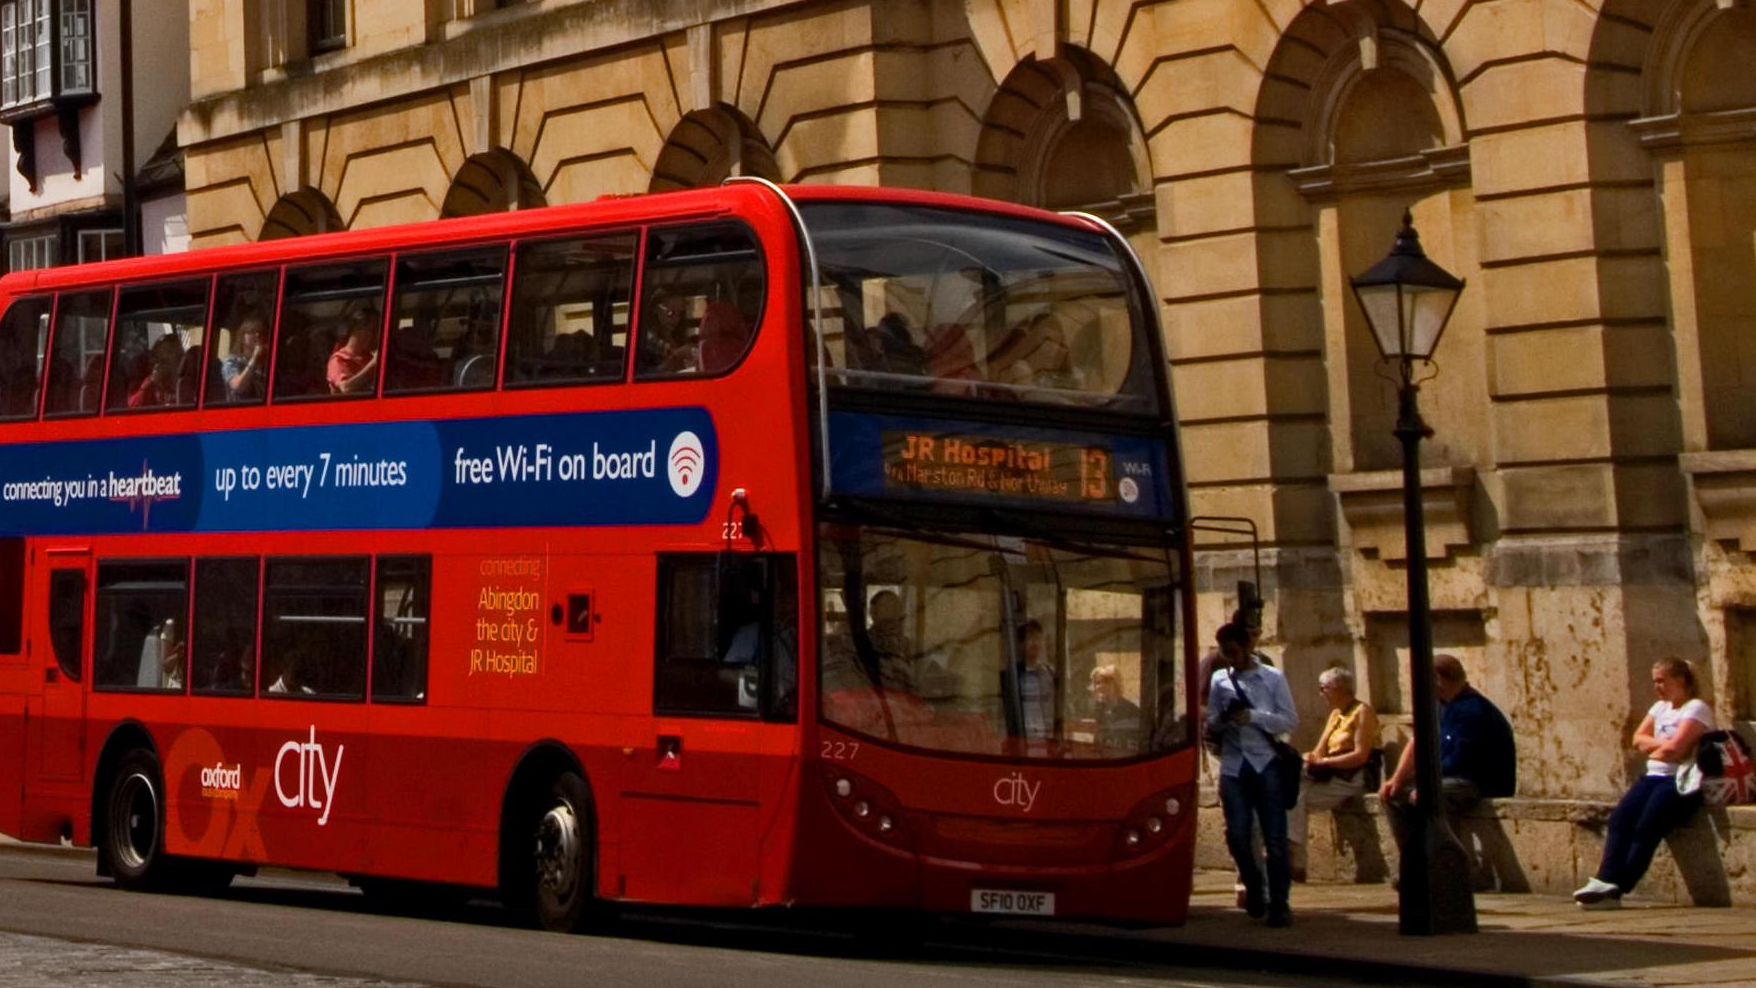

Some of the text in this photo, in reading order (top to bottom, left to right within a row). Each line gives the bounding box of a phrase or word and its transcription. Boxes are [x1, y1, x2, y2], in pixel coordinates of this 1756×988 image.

[454, 439, 656, 484] free Wi-Fi on board
[901, 435, 1051, 471] JR Hospital
[3, 469, 182, 507] connecting you in a heartbeat
[215, 452, 407, 501] up to every 7 minutes
[906, 462, 964, 486] Marston
[966, 467, 985, 488] Rd
[1080, 448, 1108, 499] 13
[480, 555, 541, 582] connecting
[478, 585, 540, 617] Abingdon
[476, 616, 538, 648] the city &
[468, 649, 538, 679] JR Hospital
[820, 740, 860, 760] 227
[201, 762, 241, 790] oxford
[274, 724, 344, 826] city
[994, 772, 1042, 813] city
[980, 892, 1046, 912] SF10 OXF
